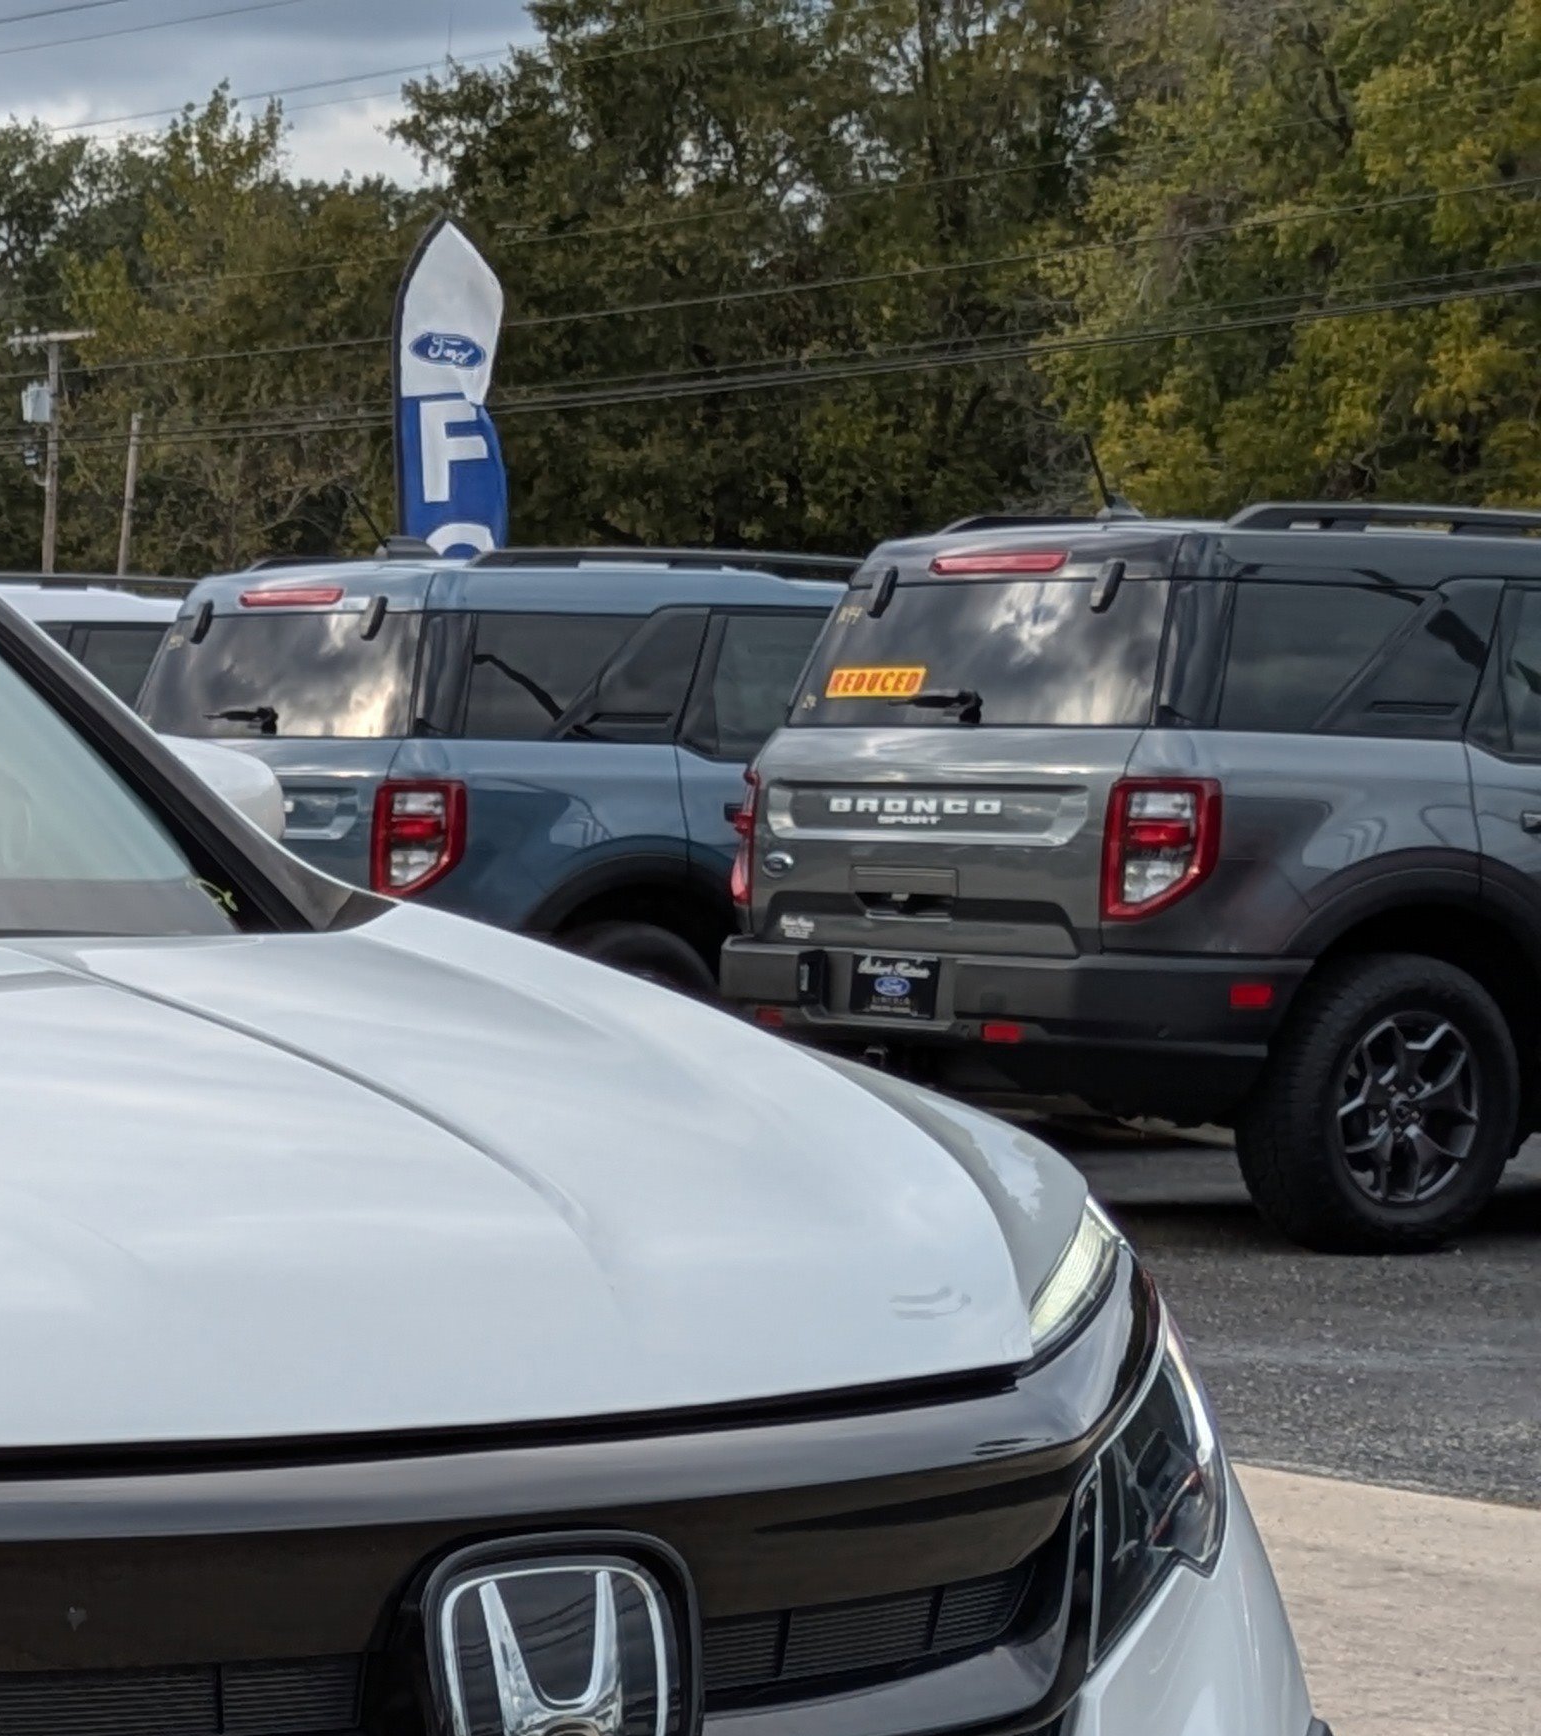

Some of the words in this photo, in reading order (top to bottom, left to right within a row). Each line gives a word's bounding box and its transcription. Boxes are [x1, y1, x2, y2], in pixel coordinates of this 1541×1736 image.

[828, 670, 921, 694] REDUCED
[828, 796, 1003, 815] BRONCO
[877, 814, 941, 825] SPORT
